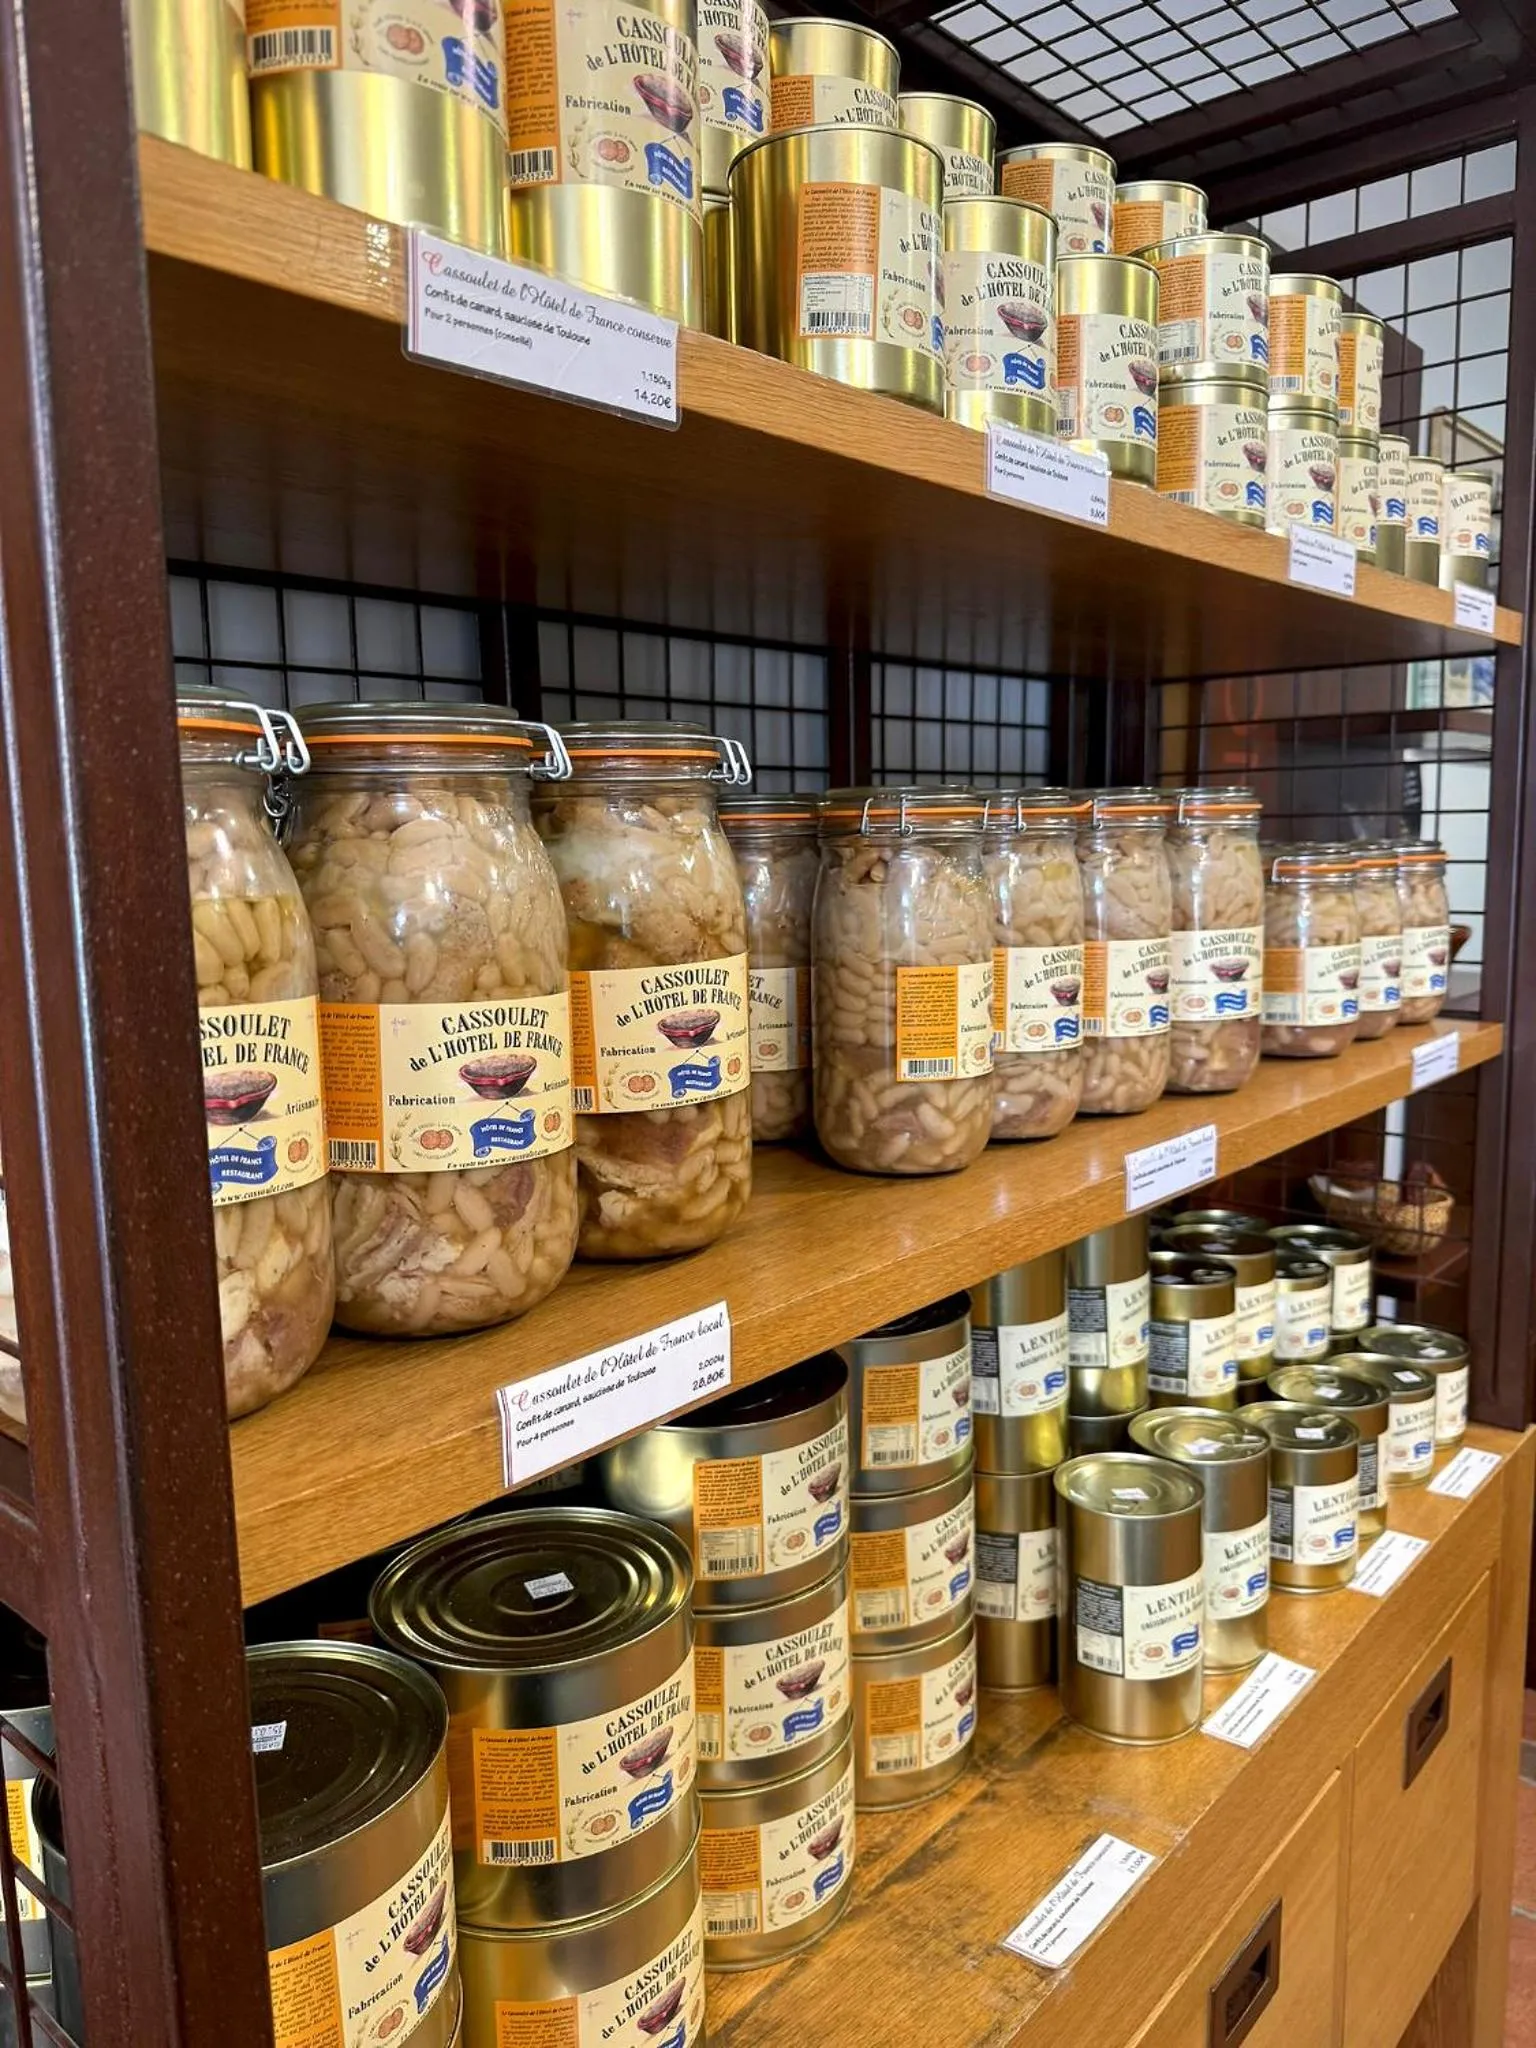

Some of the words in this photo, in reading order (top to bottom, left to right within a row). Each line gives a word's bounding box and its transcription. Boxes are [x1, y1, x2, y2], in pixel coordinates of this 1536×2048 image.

[586, 54, 604, 71] de
[565, 95, 631, 116] Fabrication
[900, 239, 910, 253] de
[422, 251, 499, 292] Cassoulet
[502, 280, 517, 298] de
[569, 302, 583, 320] de
[882, 269, 926, 292] Fabrication
[961, 293, 974, 307] de
[1099, 350, 1110, 364] de
[1200, 932, 1257, 949] CASSOULET
[641, 968, 730, 995] CASSOULET
[616, 1013, 631, 1028] de
[692, 988, 707, 1004] DE
[711, 988, 742, 1011] FRANCE
[750, 989, 783, 1010] RANCE
[441, 1007, 549, 1036] CASSOULET
[236, 1042, 257, 1063] DE
[264, 1042, 309, 1075] FRANCE
[409, 1056, 428, 1072] de
[504, 1031, 522, 1048] DE
[526, 1031, 564, 1058] FRANCE
[600, 1046, 656, 1058] Fabrication
[388, 1094, 455, 1107] Fabrication
[221, 1169, 264, 1180] RESTAURANT
[511, 1374, 580, 1412] Cassoulet
[584, 1366, 598, 1383] de
[645, 1341, 659, 1359] de
[660, 1332, 697, 1352] France
[541, 1410, 553, 1421] de
[615, 1379, 625, 1390] de
[780, 1484, 792, 1496] de
[765, 1622, 834, 1662] CASSOULET
[744, 1678, 757, 1690] de
[605, 1680, 682, 1738] CASSOULET
[728, 1702, 774, 1715] Fabrication
[581, 1760, 596, 1775] de
[650, 1711, 663, 1730] DE
[564, 1785, 618, 1808] Fabrication
[778, 1848, 790, 1861] de
[766, 1868, 806, 1888] Fabrication
[364, 1954, 381, 1973] de
[624, 1930, 694, 2001] CASSOULET
[348, 1973, 404, 2020] Fabrication
[601, 2025, 616, 2040] de
[665, 1966, 678, 1985] DE
